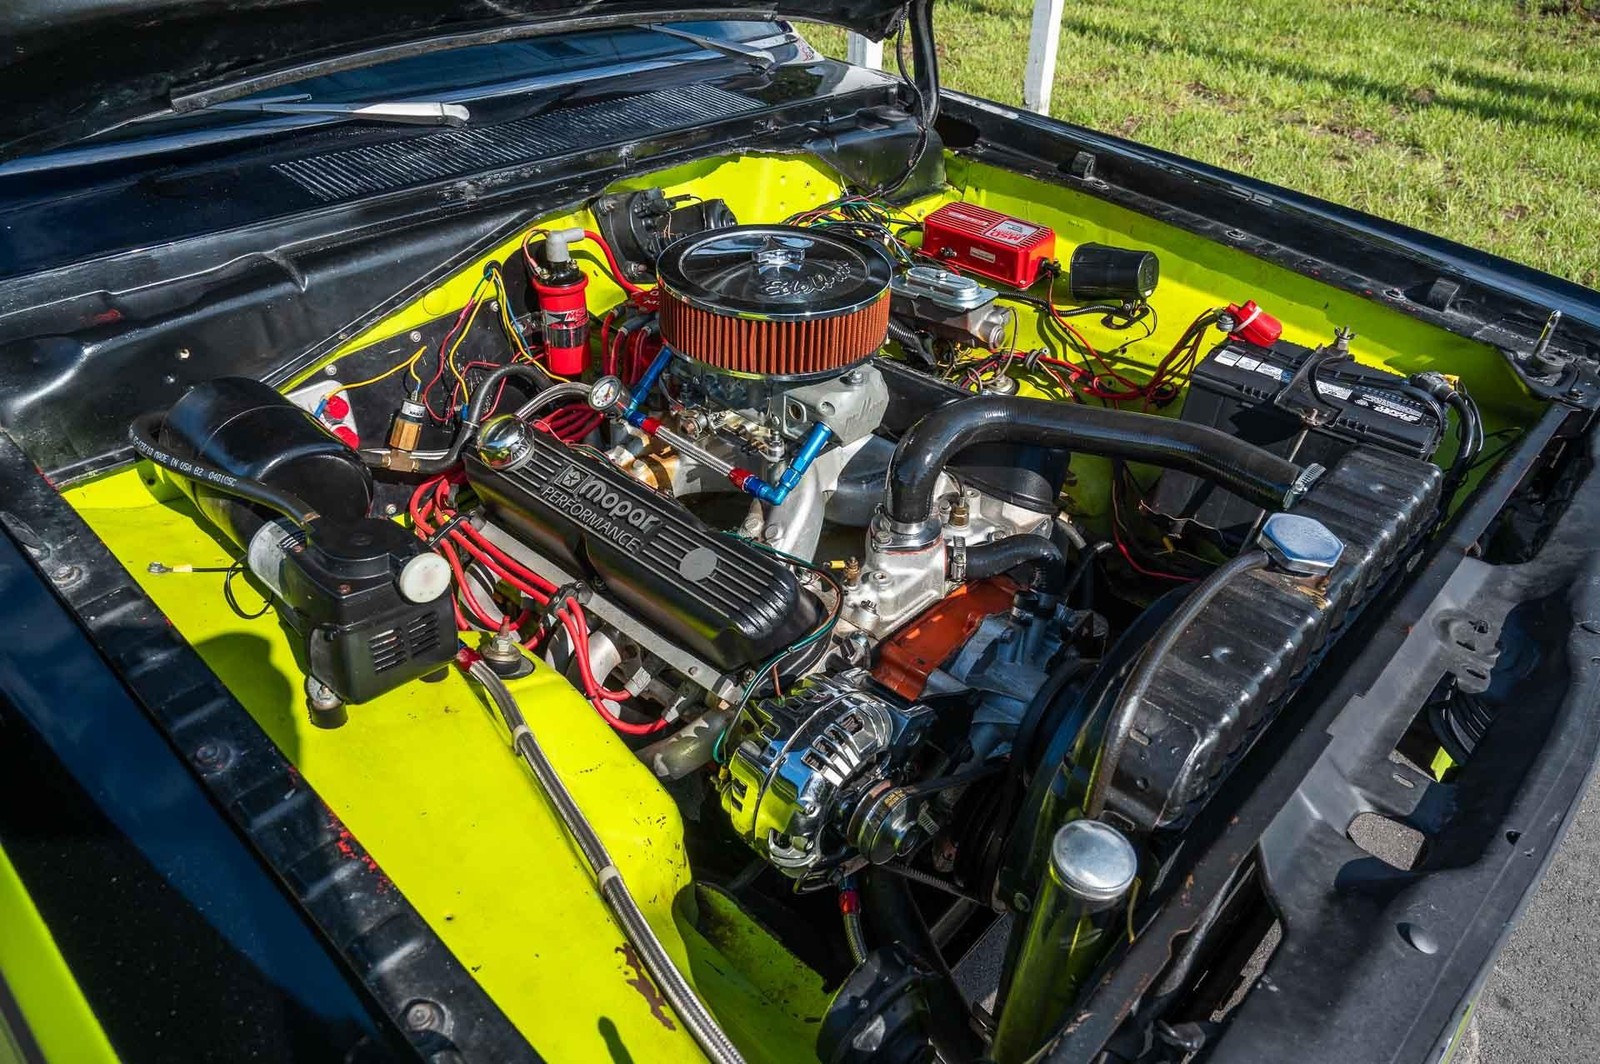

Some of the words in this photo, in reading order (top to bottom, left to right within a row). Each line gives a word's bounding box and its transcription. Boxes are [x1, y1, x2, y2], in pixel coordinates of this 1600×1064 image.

[154, 450, 169, 464] MADE
[170, 457, 179, 468] IN
[179, 461, 193, 473] USA
[541, 487, 642, 552] PERFORMANCE
